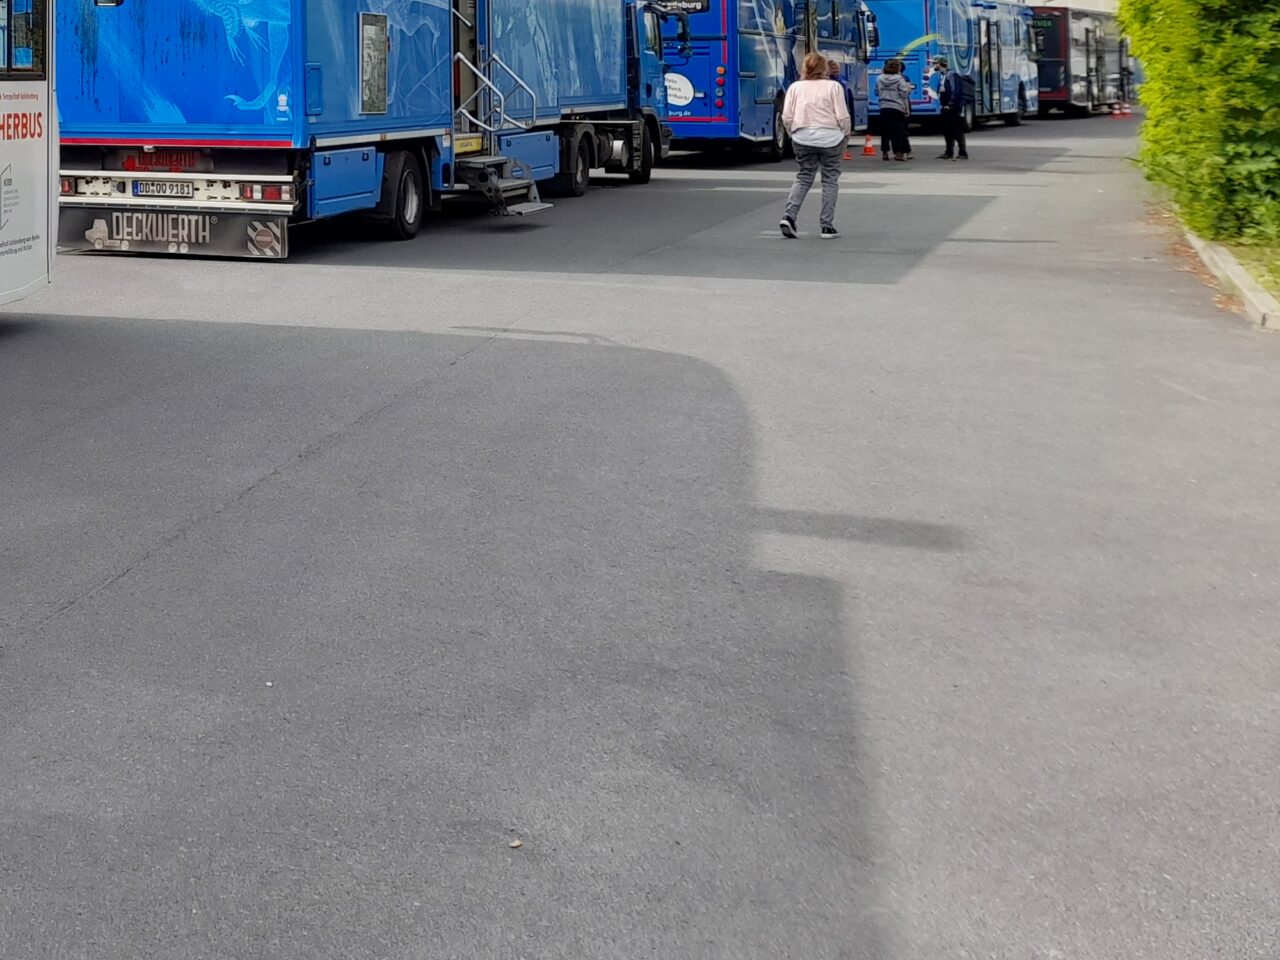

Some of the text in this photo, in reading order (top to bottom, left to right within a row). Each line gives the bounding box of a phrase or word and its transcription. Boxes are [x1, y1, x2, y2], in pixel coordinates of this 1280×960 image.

[139, 182, 151, 194] DD
[169, 184, 191, 196] 9181
[112, 212, 210, 244] DECKWERTH
